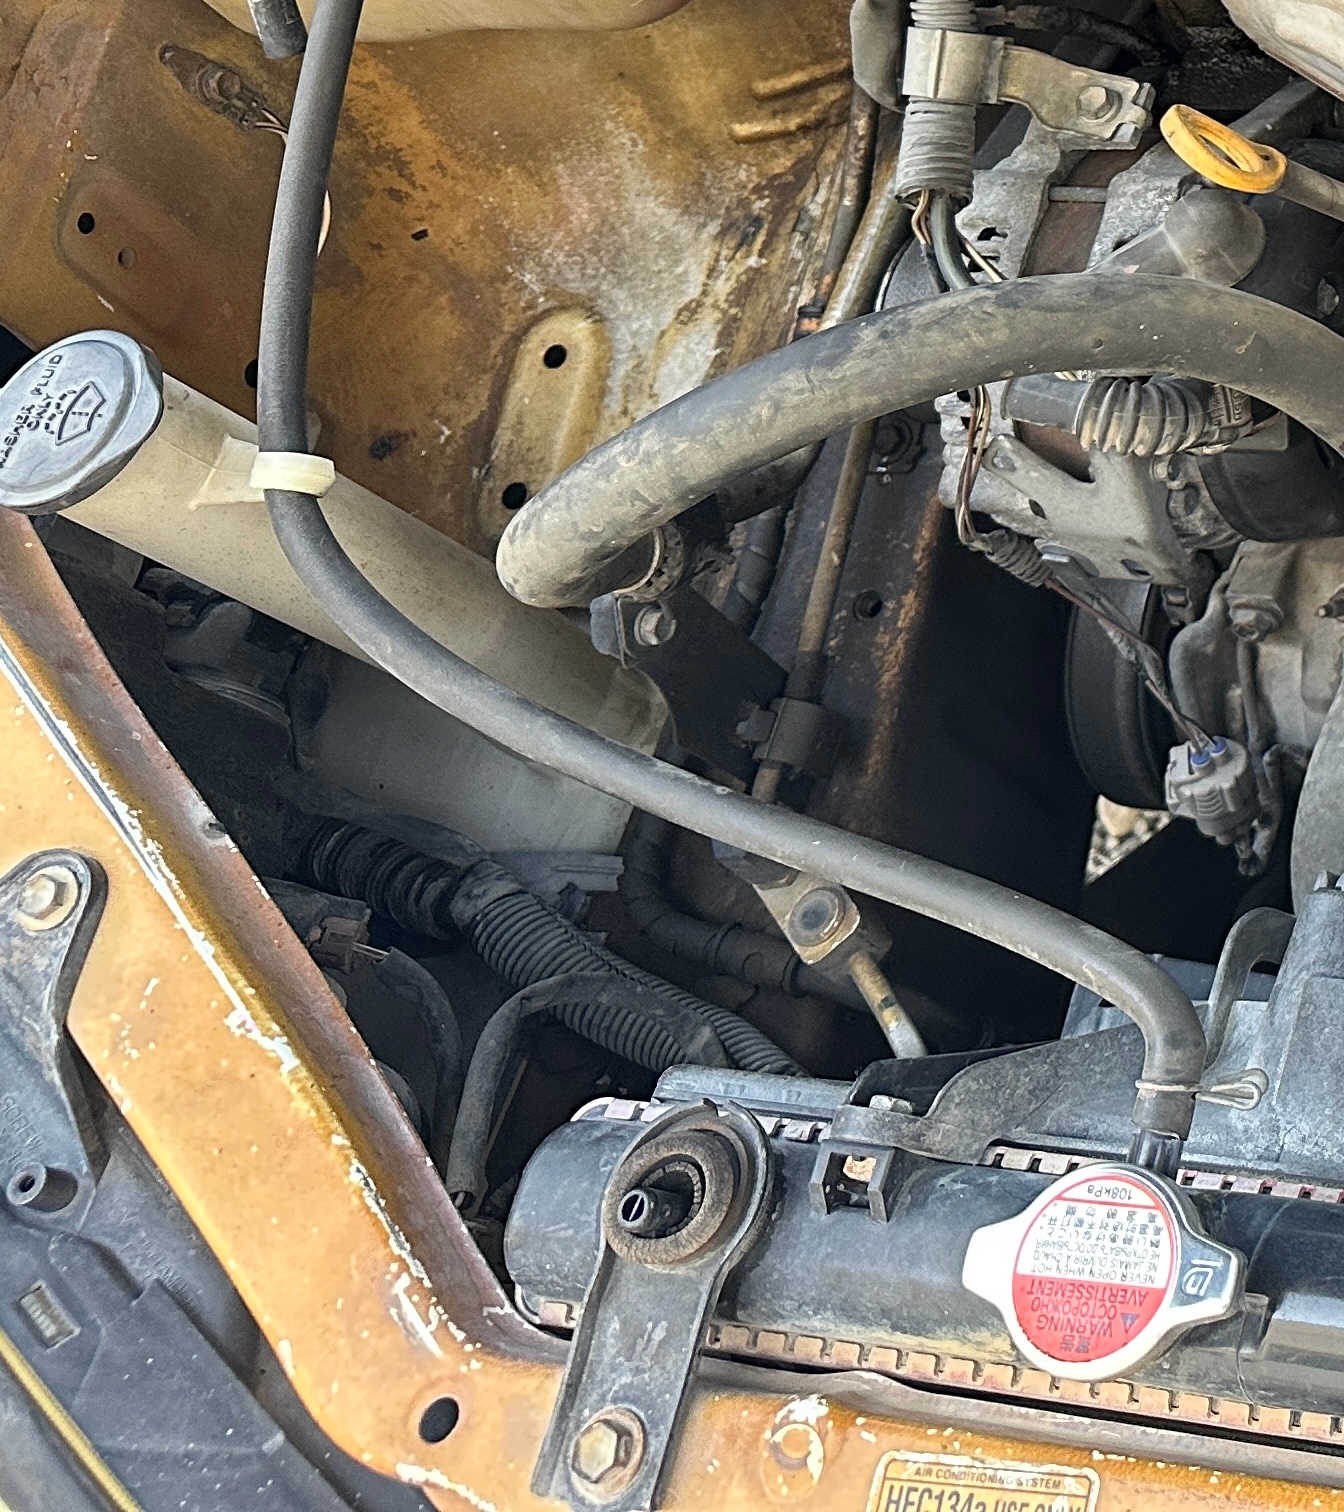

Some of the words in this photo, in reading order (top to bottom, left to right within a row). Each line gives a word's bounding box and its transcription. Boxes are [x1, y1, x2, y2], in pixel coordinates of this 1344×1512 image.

[30, 354, 63, 396] FLUID
[26, 392, 54, 431] ONLY
[1087, 1184, 1133, 1201] 108kPa
[1031, 1263, 1053, 1274] HOT
[1056, 1265, 1085, 1277] WHEN
[1088, 1268, 1117, 1281] OPEN
[1121, 1271, 1155, 1284] NEVER
[1026, 1279, 1149, 1307] AVERTISSEMENT
[1031, 1296, 1117, 1320] ОСТОРОЖНО
[1036, 1314, 1113, 1338] WARNING
[914, 1465, 933, 1478] AIR
[936, 1468, 1013, 1486] CONDITIONING
[1016, 1473, 1061, 1489] SYSTEM
